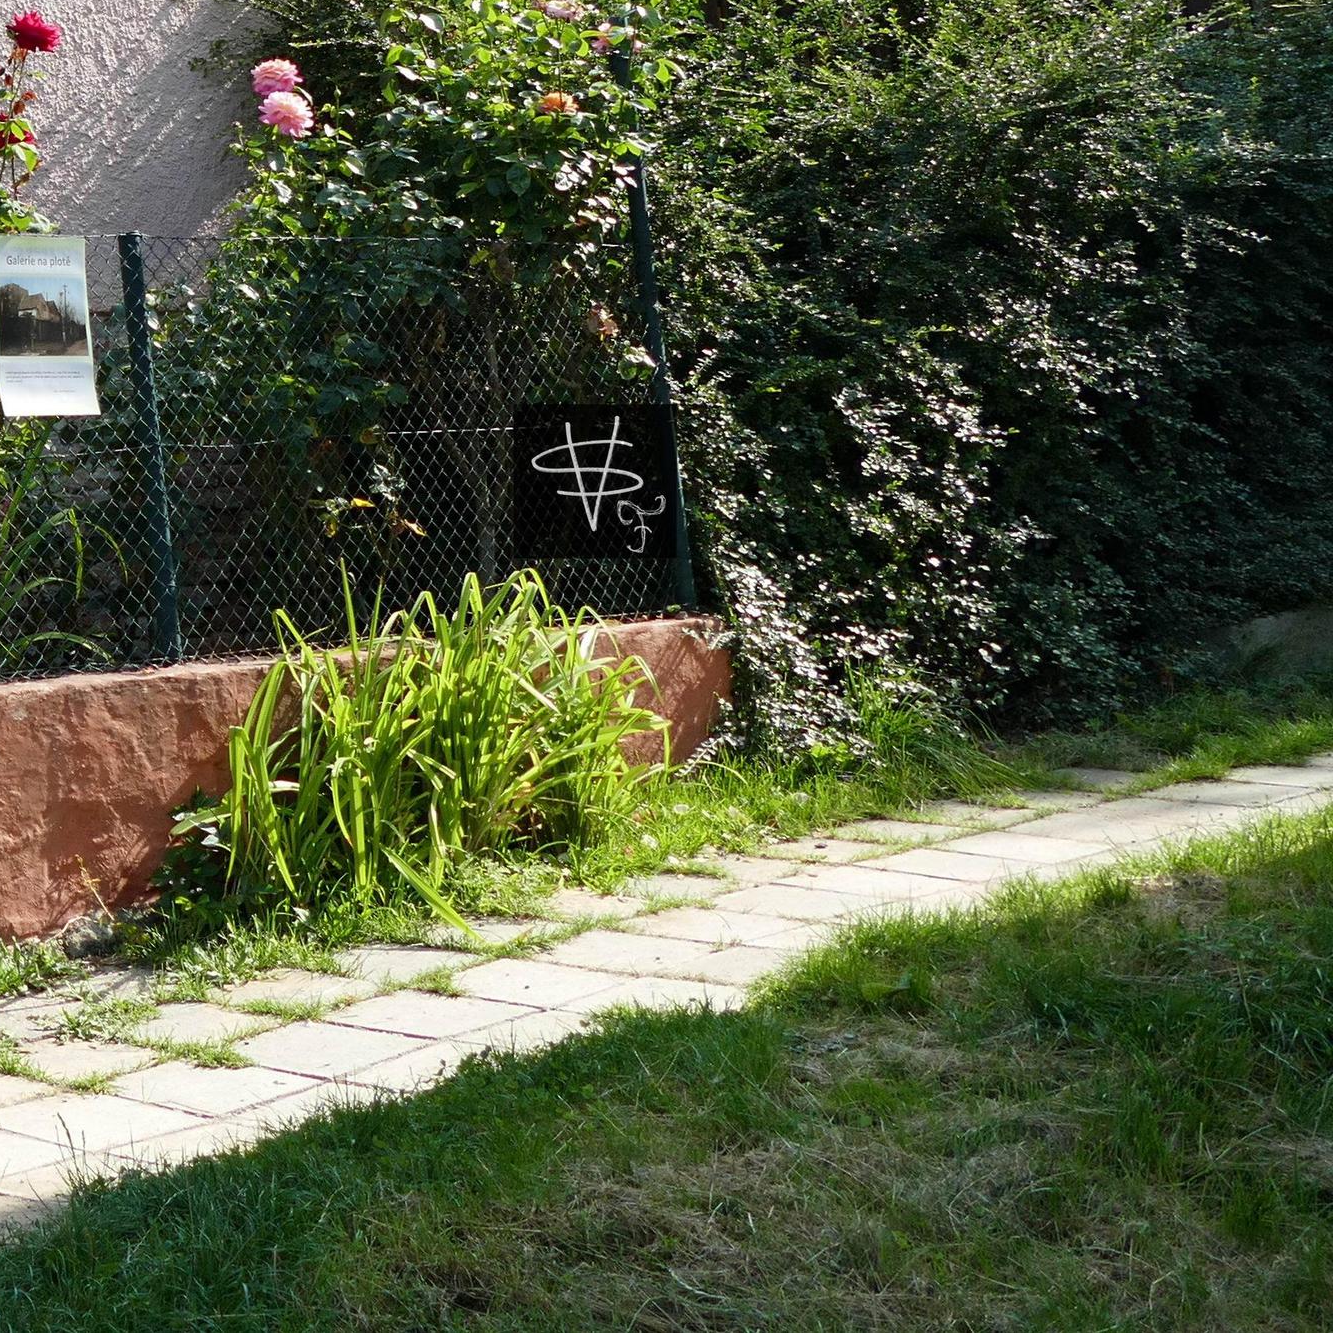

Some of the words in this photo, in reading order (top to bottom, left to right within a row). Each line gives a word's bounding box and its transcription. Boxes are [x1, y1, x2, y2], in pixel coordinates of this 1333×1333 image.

[6, 255, 36, 266] Galerie
[37, 258, 48, 267] na
[49, 255, 71, 268] plotě
